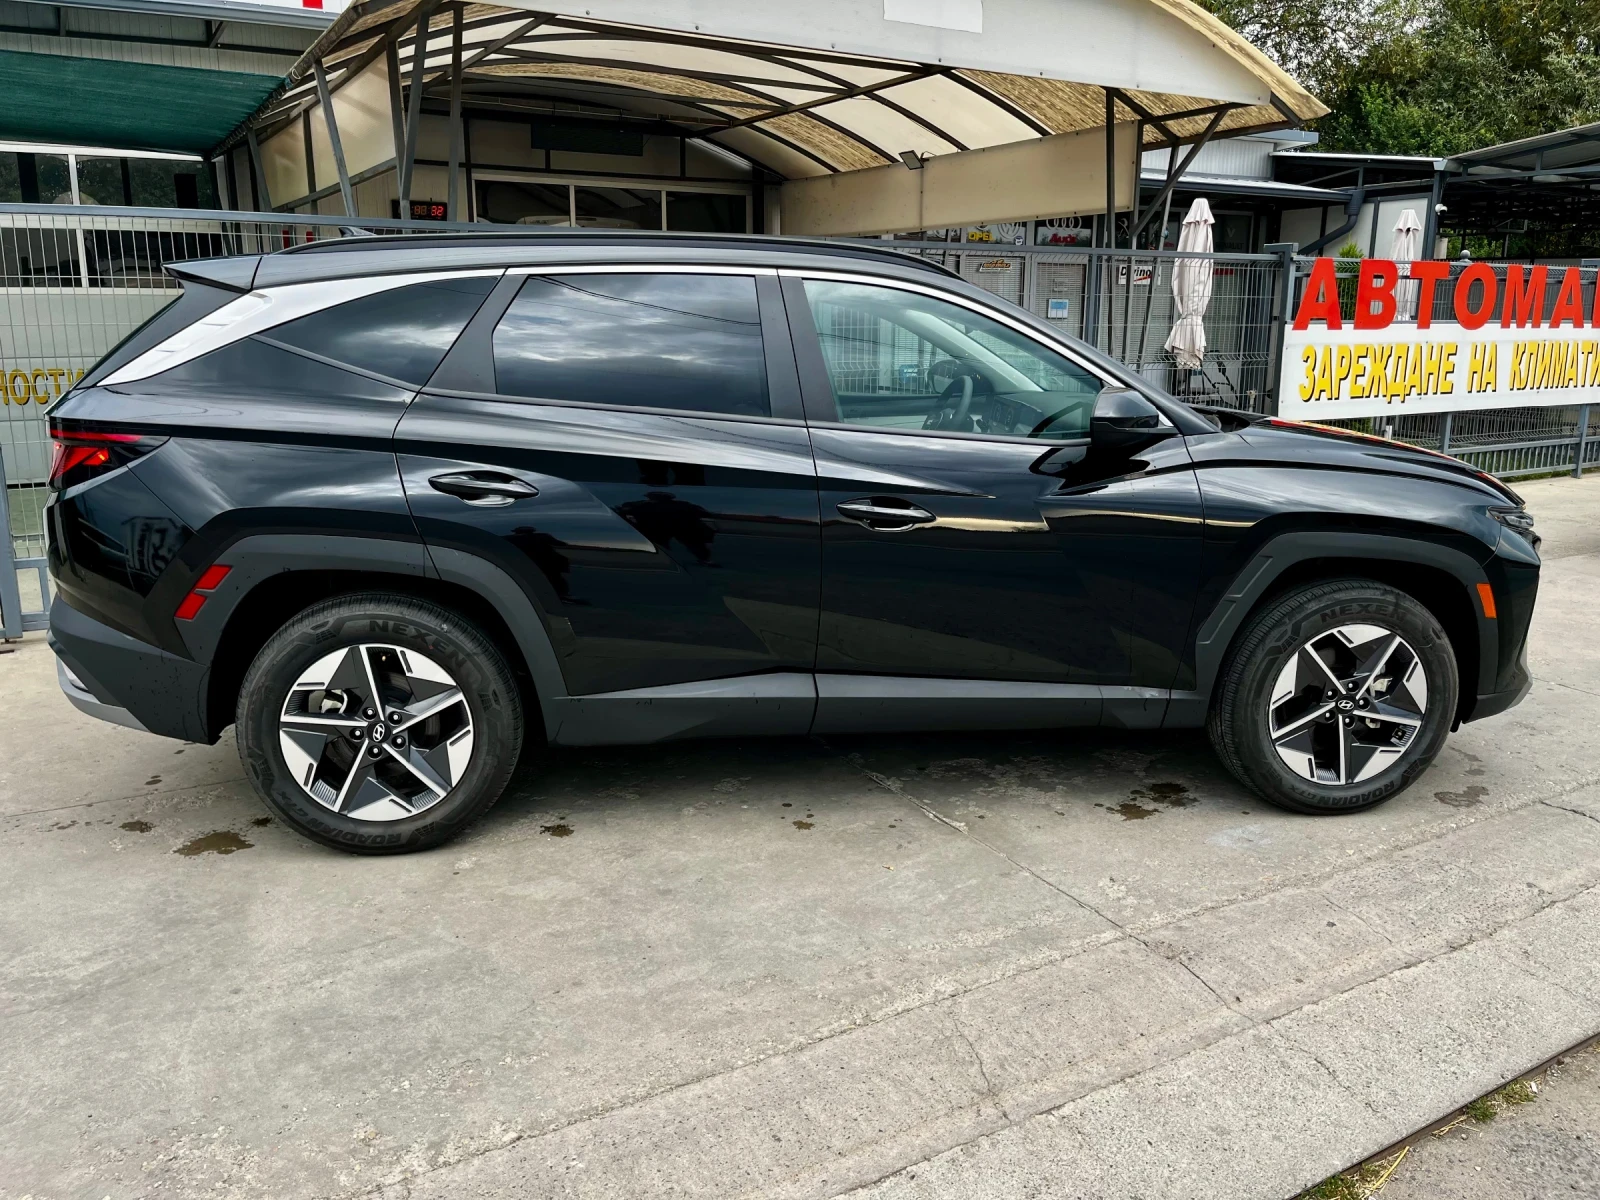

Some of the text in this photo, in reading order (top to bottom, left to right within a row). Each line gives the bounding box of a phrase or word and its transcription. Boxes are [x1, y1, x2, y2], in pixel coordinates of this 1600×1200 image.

[968, 231, 995, 241] OPEL
[1292, 257, 1600, 330] АВТОМА
[1299, 342, 1458, 404] ЗАРЕЖДАНЕ
[1467, 342, 1497, 393] НА
[1320, 603, 1407, 623] NEXEN
[369, 620, 467, 671] NEXEN
[306, 818, 402, 845] ROADIAN
